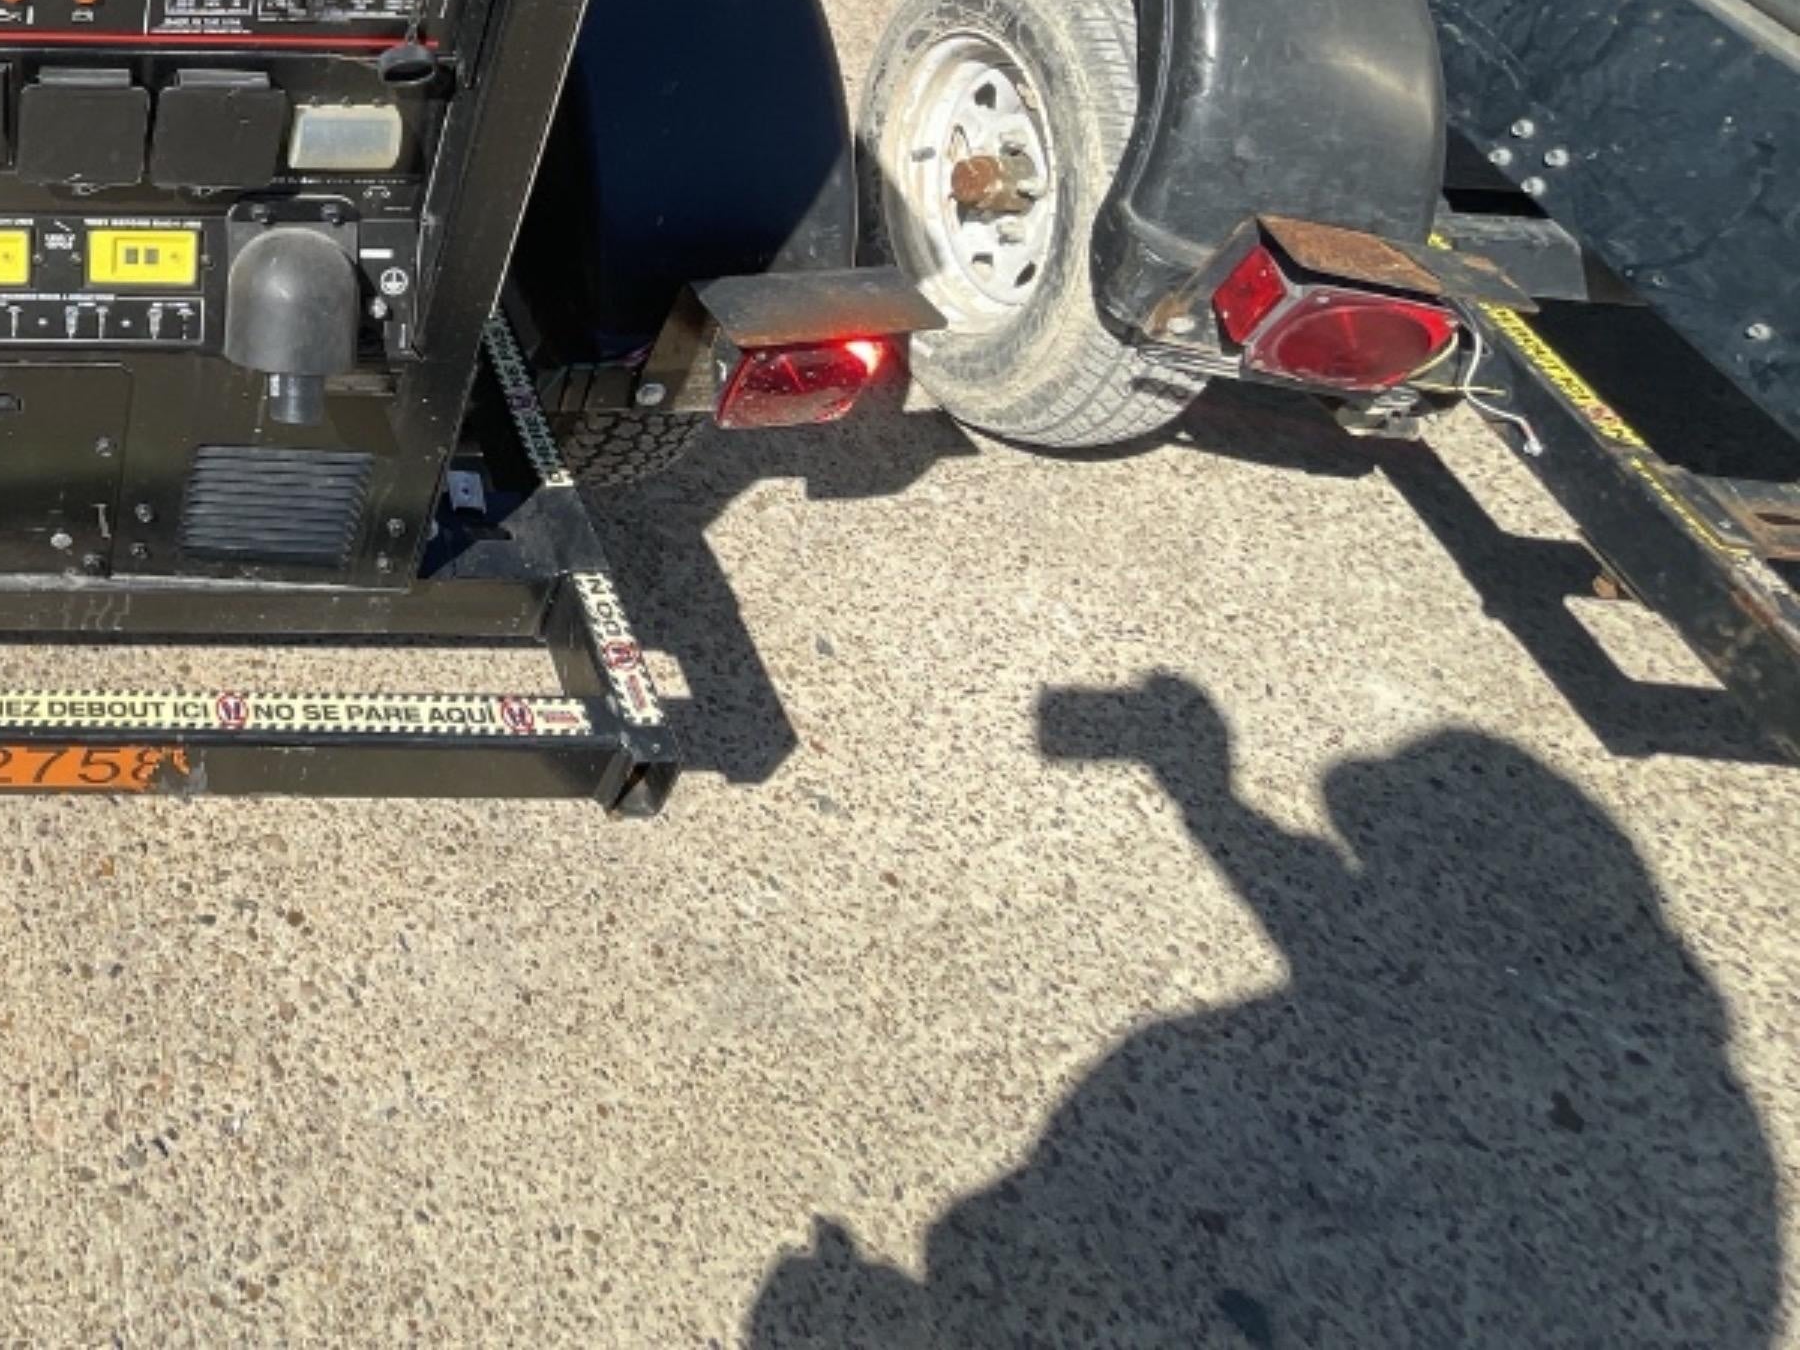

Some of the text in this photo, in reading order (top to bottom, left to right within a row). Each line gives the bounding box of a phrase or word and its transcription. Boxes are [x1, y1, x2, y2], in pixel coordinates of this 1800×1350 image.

[48, 702, 166, 719] DEBOUT
[174, 701, 209, 718] ICI
[254, 704, 294, 721] NO
[302, 705, 340, 721] SE
[347, 705, 421, 722] PARE
